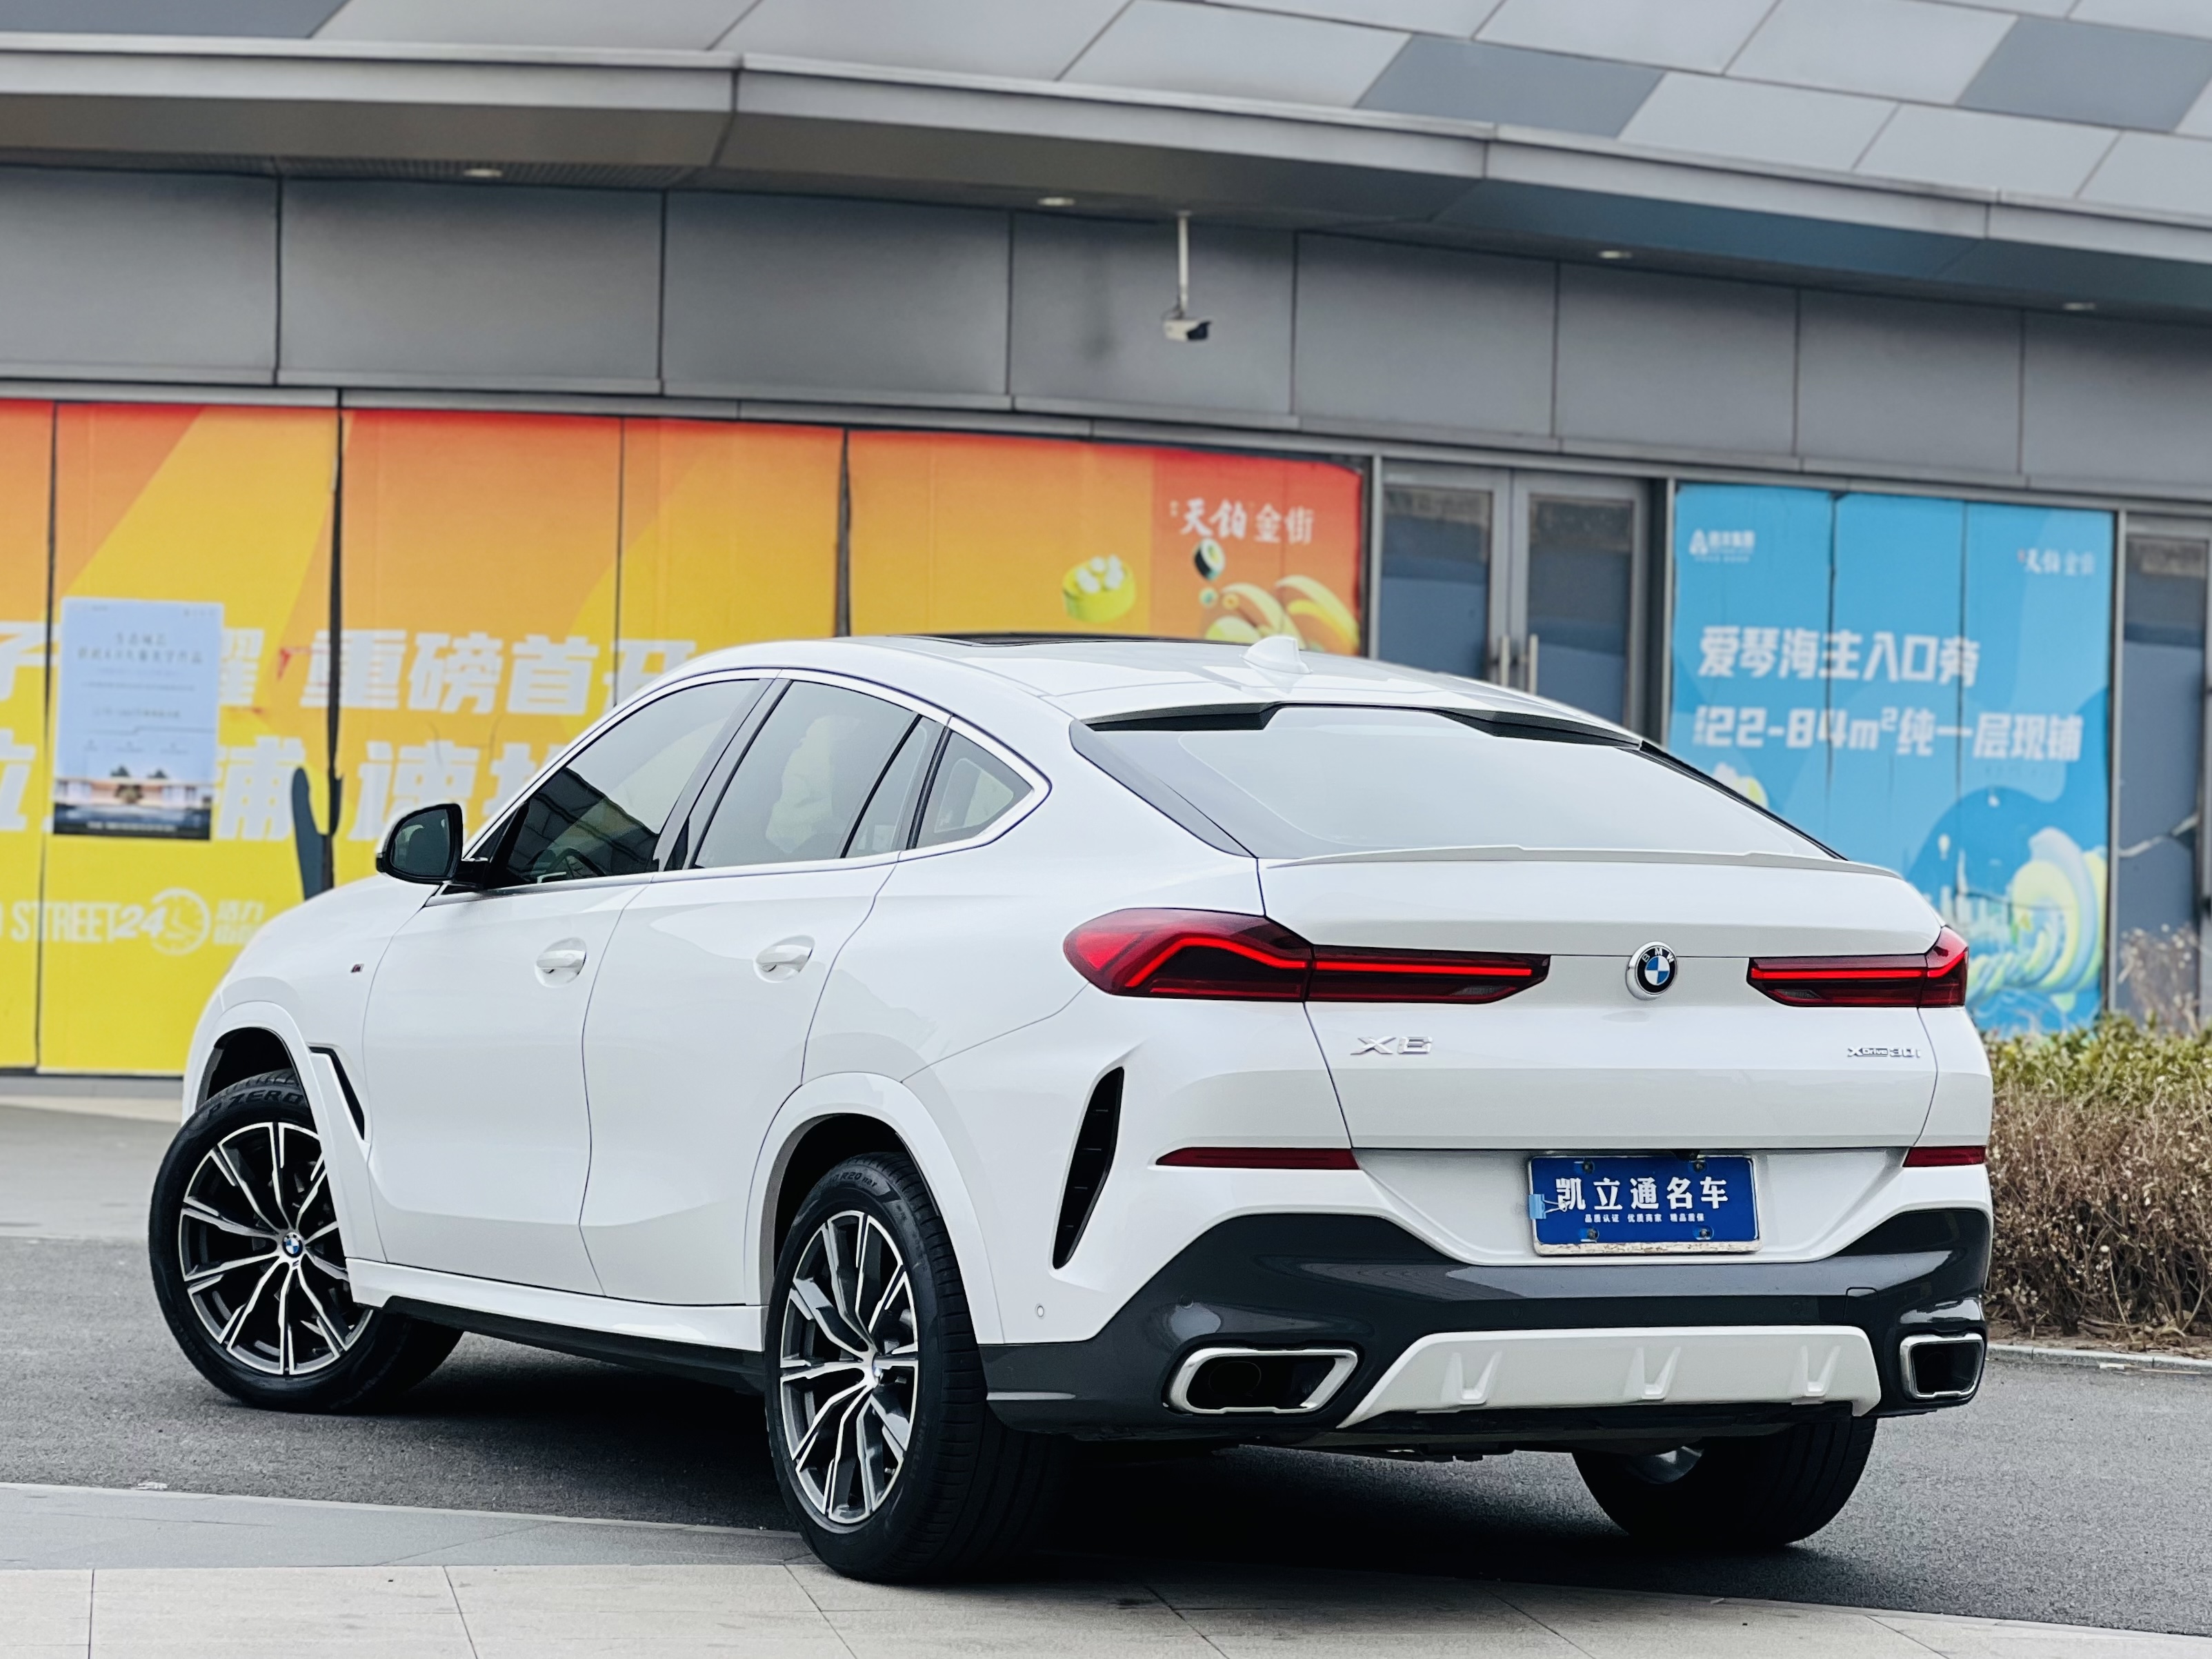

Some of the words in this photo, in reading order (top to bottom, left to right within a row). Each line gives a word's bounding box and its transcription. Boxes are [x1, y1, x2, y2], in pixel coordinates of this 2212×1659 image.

[1697, 626, 1980, 688] 爱琴海主入口旁
[1350, 1035, 1433, 1055] X6
[1555, 1176, 1728, 1211] 凯立通名车
